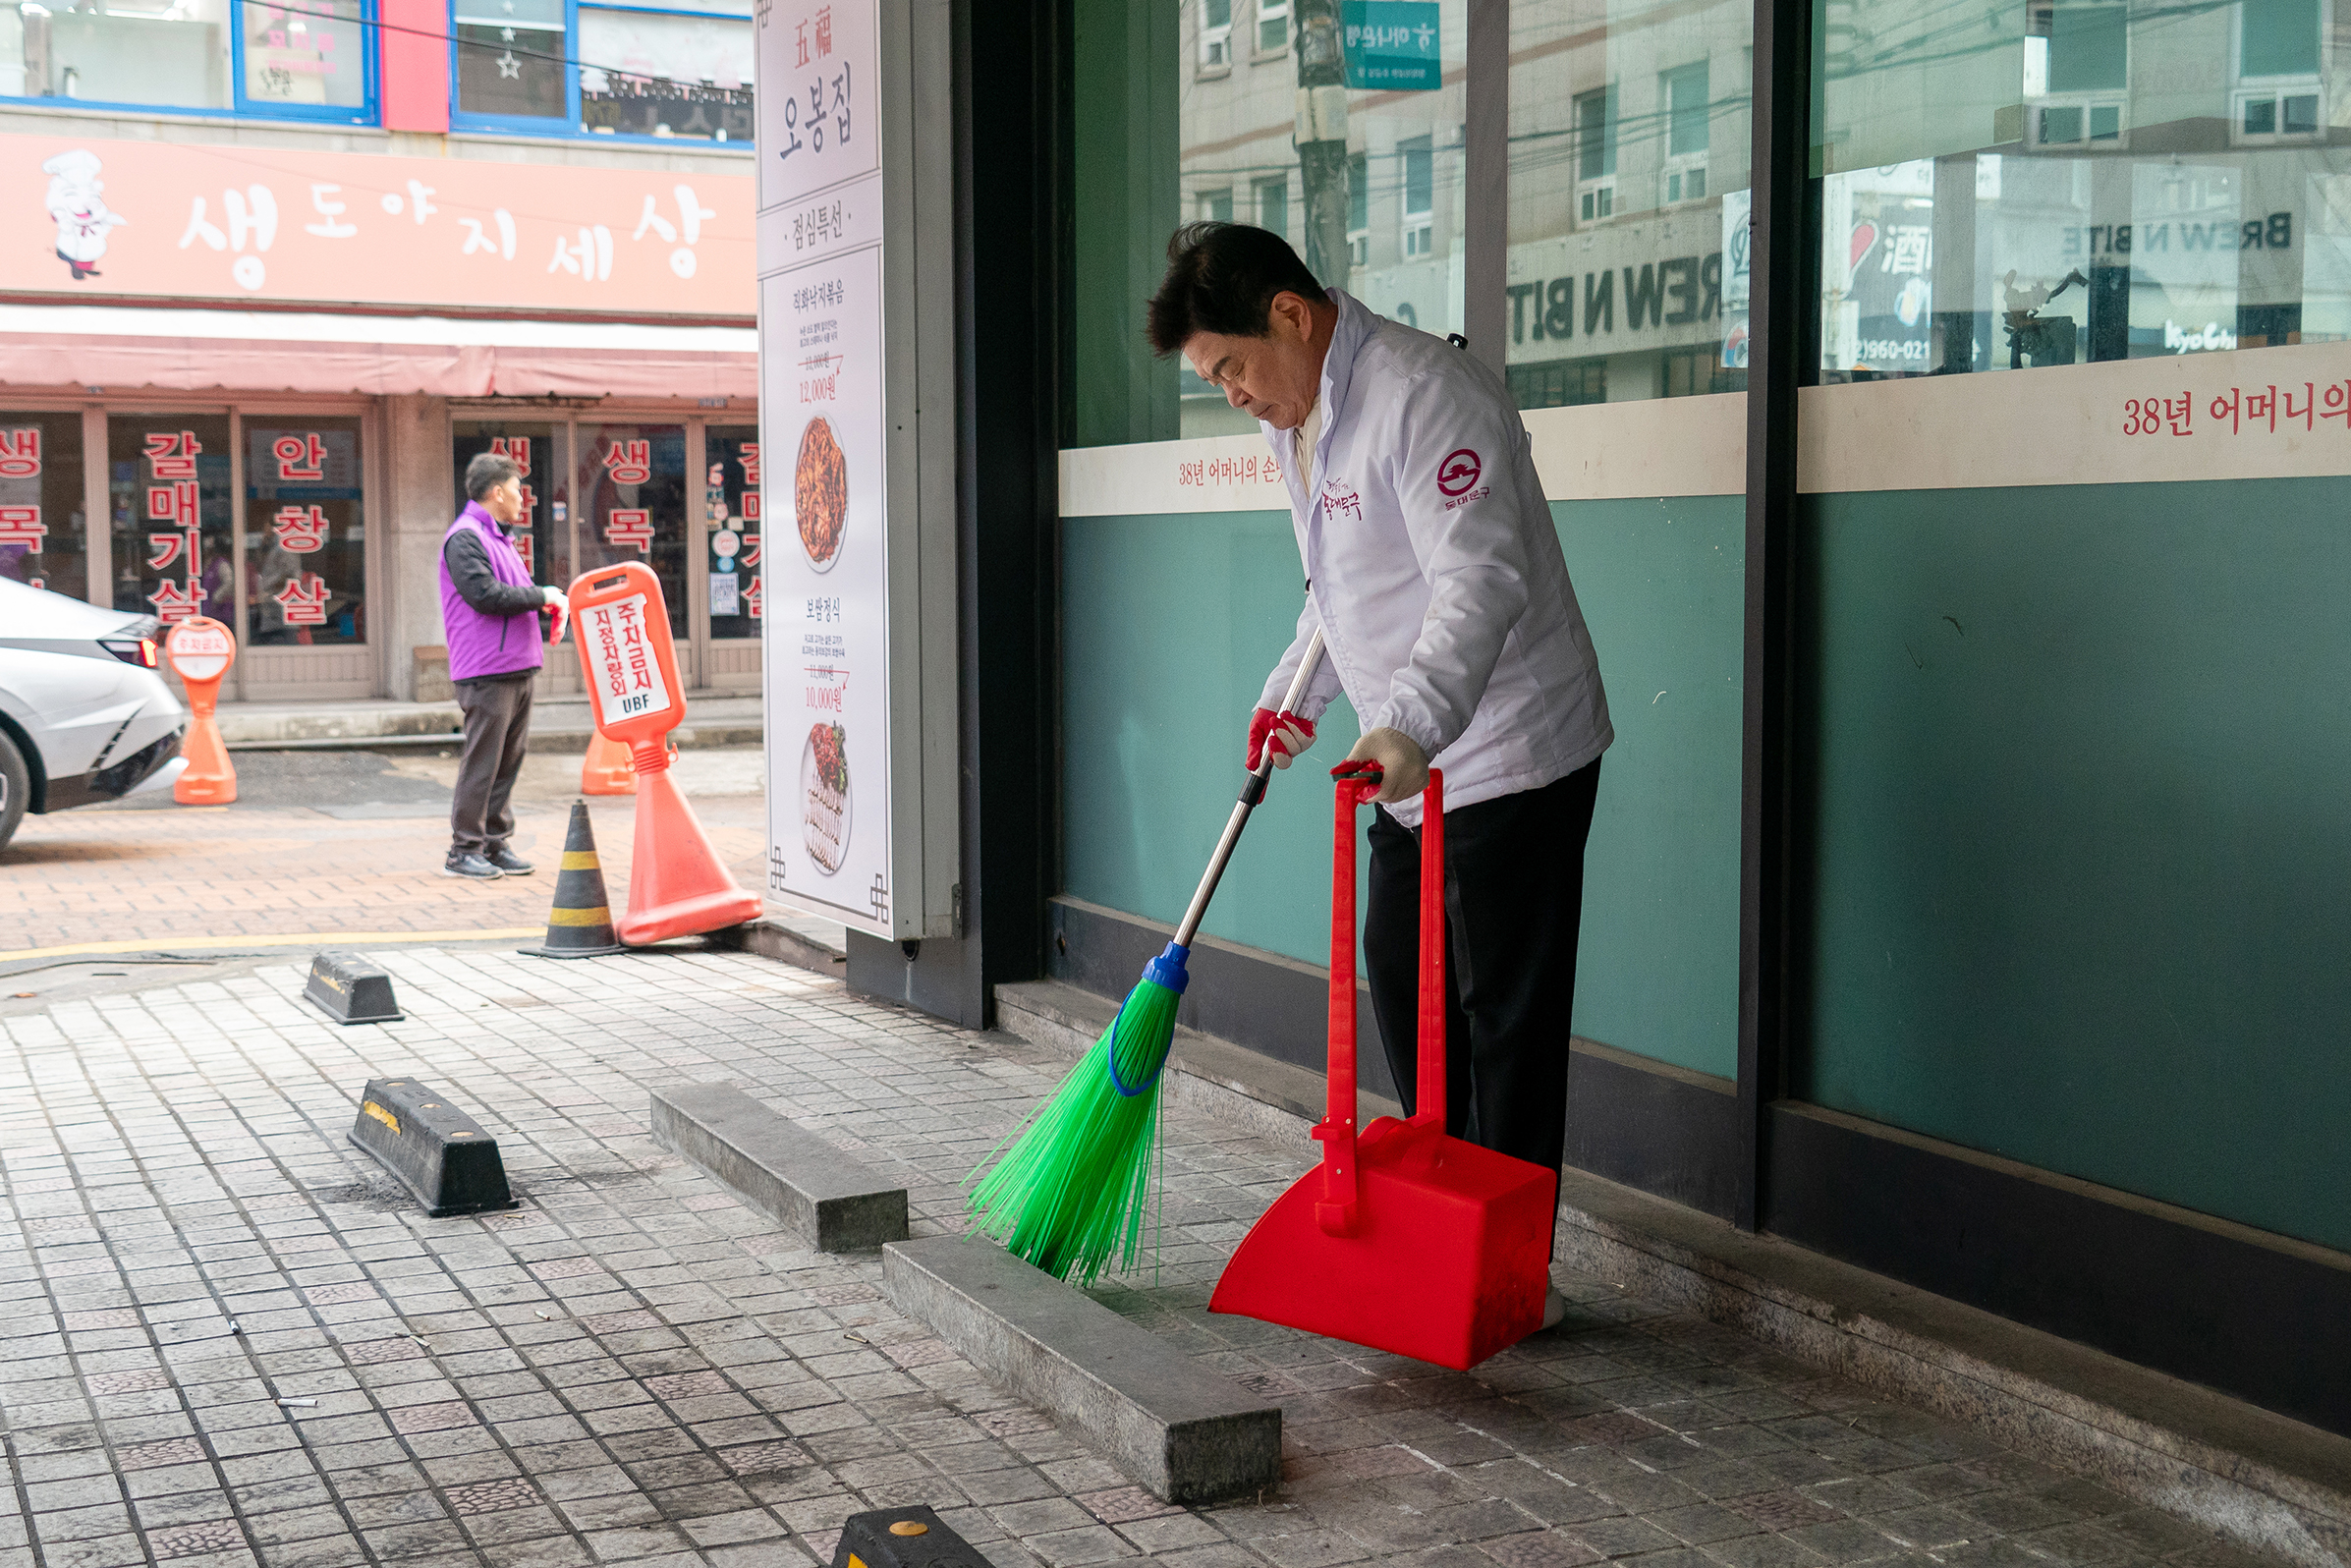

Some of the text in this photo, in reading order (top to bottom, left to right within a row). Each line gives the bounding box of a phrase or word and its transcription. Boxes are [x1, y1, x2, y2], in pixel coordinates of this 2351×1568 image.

[779, 60, 853, 160] 오봉집
[793, 199, 843, 252] 점심특선
[793, 278, 845, 314] 직화낙지볶음
[800, 373, 836, 405] 12,000원
[2122, 378, 2351, 437] 38년 어머니의
[1179, 459, 1204, 487] 38년
[1208, 455, 1258, 486] 어머니의
[0, 428, 49, 589] 생목
[1321, 491, 1363, 522] 동대문구
[1444, 486, 1490, 512] 동대문구
[142, 429, 208, 626] 갈매기살
[272, 431, 332, 626] 안창살
[806, 596, 841, 623] 보쌈정식
[617, 601, 653, 691] 주차금지
[622, 693, 650, 714] UBF
[806, 686, 842, 713] 10,000원
